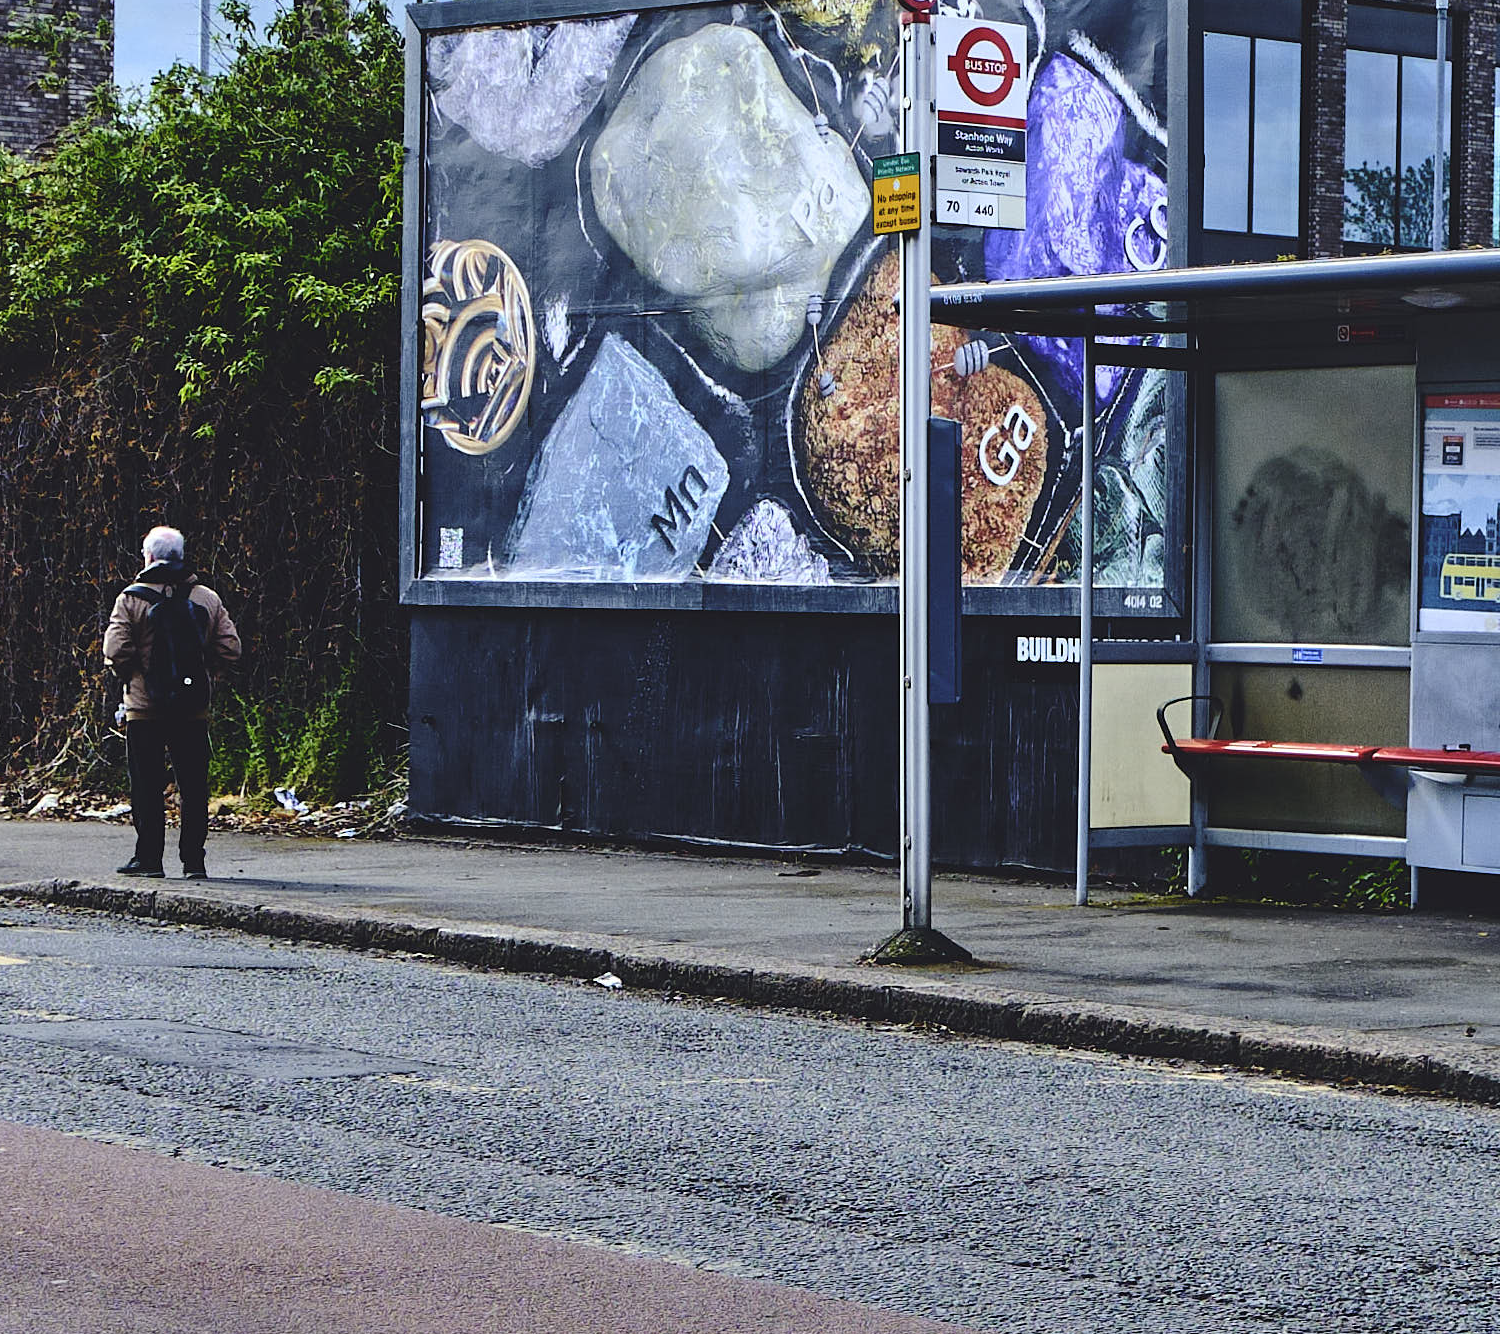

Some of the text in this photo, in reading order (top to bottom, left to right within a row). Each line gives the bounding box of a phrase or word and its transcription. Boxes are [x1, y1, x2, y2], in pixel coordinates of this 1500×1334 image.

[964, 59, 1007, 74] BUS STOP
[955, 129, 1013, 147] Stanhope Way
[877, 191, 916, 204] No stopping
[879, 204, 915, 216] at any time
[946, 200, 994, 217] 70 440
[876, 217, 918, 229] except buses
[977, 404, 1038, 487] Ga
[651, 464, 709, 556] Mn
[1124, 595, 1163, 609] 4014 02
